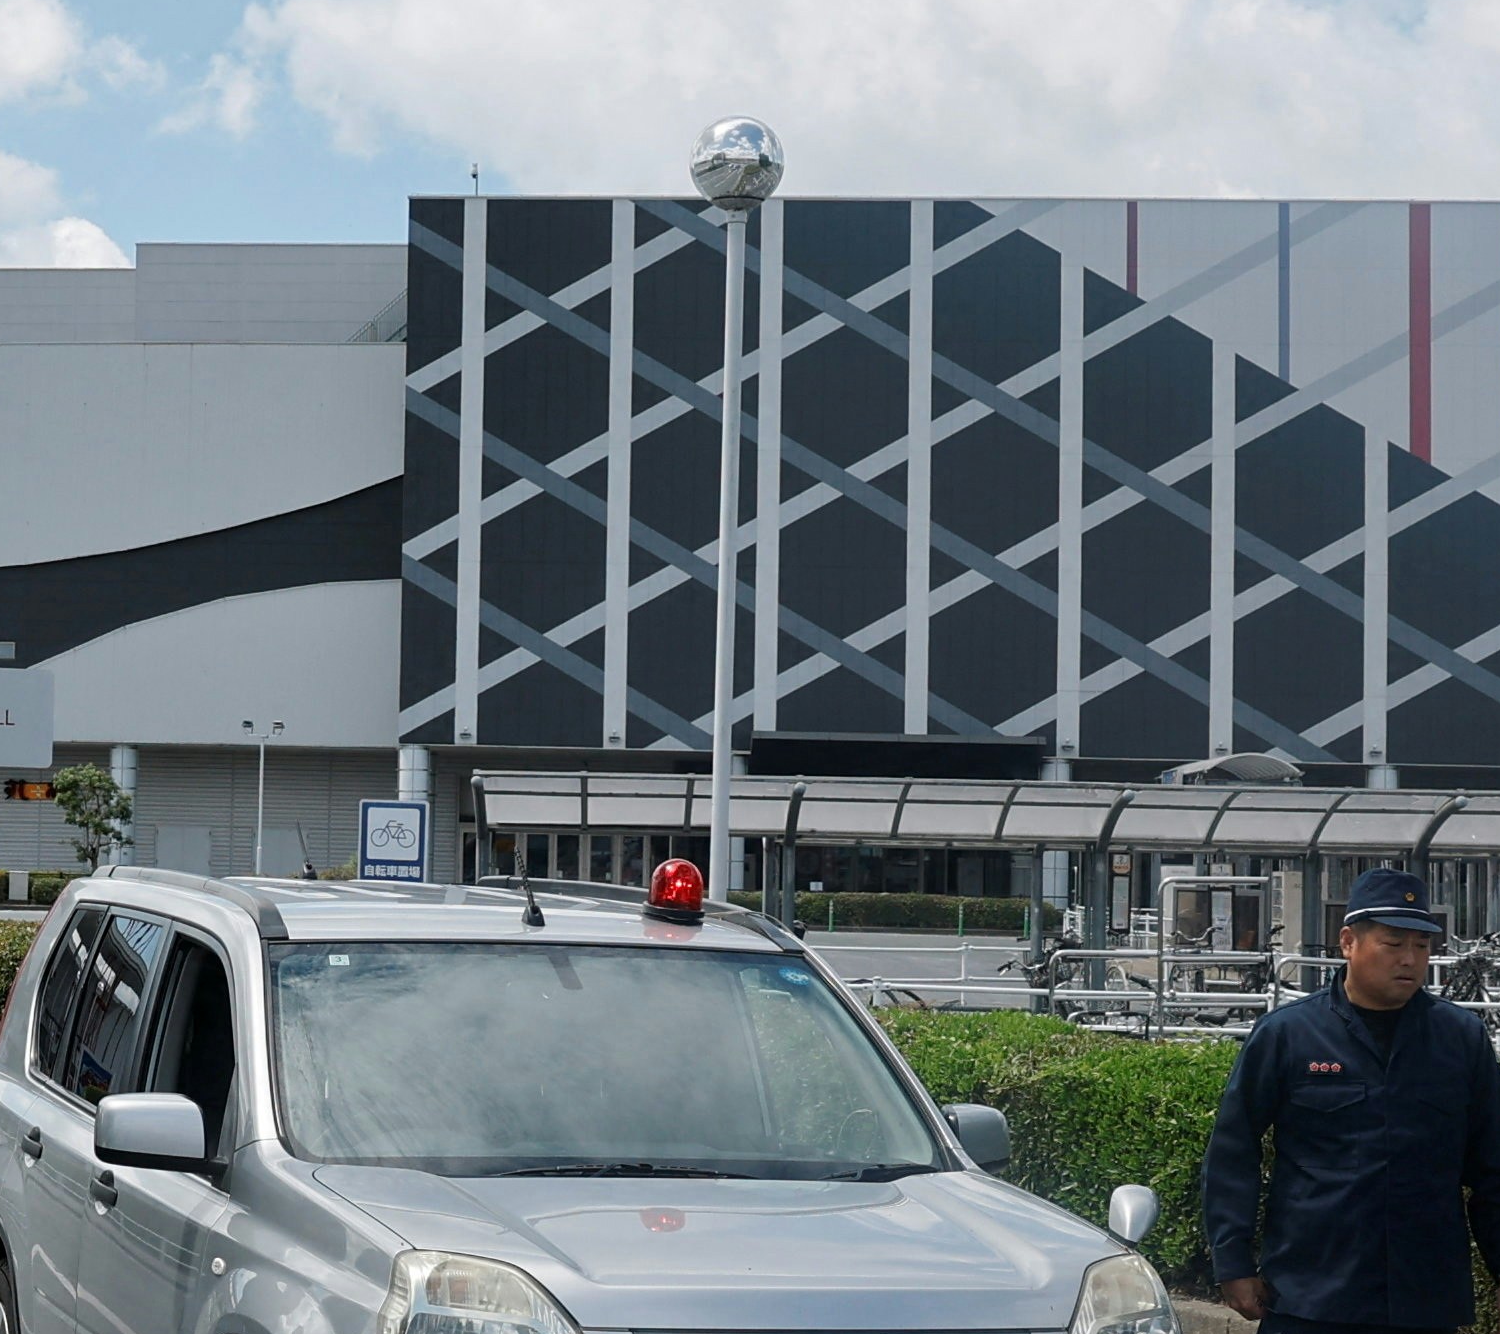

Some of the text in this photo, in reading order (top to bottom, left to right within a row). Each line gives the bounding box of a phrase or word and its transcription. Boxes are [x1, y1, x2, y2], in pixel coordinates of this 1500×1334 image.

[363, 864, 421, 879] 自転車置場
